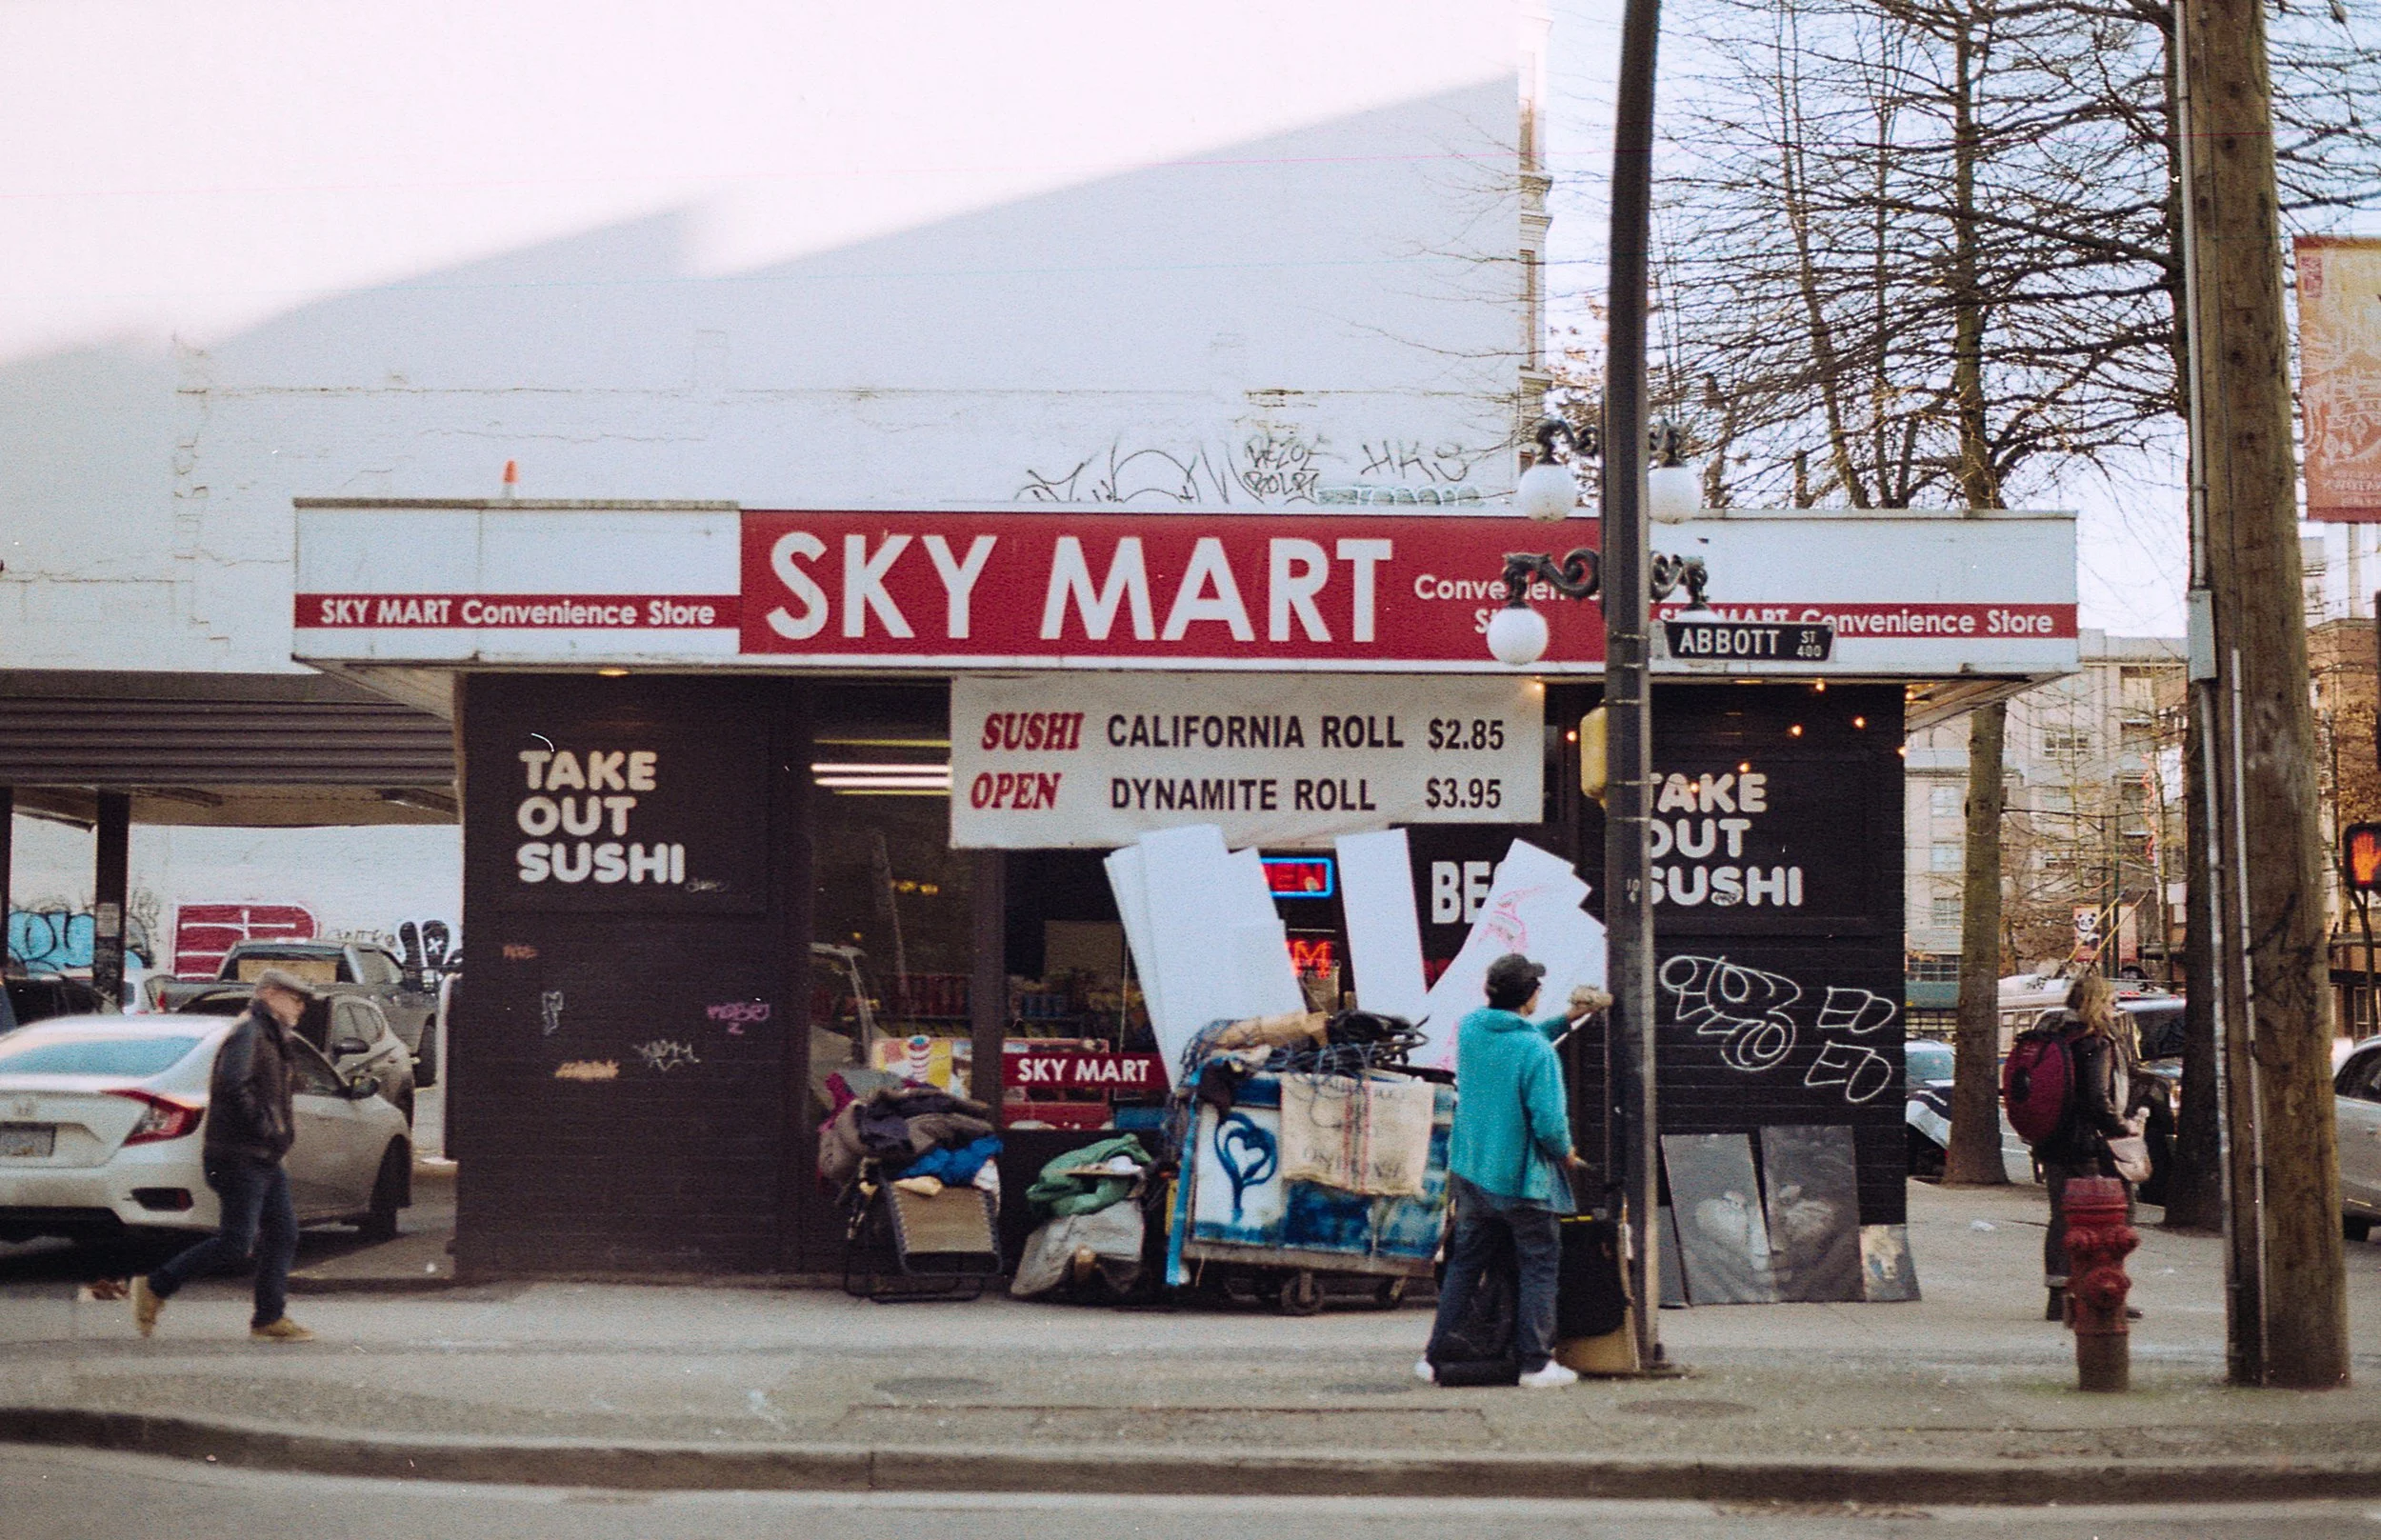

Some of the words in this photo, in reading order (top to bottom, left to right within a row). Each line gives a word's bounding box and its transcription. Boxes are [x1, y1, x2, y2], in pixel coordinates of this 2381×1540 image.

[766, 531, 997, 640] SKY
[1040, 536, 1392, 643] MART
[320, 599, 370, 624] SKY
[376, 599, 452, 624] MART
[461, 599, 637, 625] Convenience
[648, 600, 715, 626] Store
[1987, 608, 2053, 634] Store
[1678, 628, 1780, 655] ABBOTT
[1801, 630, 1815, 644] ST
[1796, 645, 1821, 657] 400
[982, 712, 1084, 751] SUSHI
[1108, 714, 1304, 749] CALIFORNIA
[1321, 714, 1404, 749] ROLL
[1428, 716, 1505, 750] $2.85
[519, 750, 657, 791] TAKE
[970, 772, 1063, 810] OPEN
[1112, 777, 1277, 810] DYNAMITE
[1294, 778, 1376, 811] ROLL
[1425, 777, 1502, 810] $3.95
[517, 795, 637, 836] OUT
[516, 842, 685, 885] SUSHI
[1262, 864, 1325, 891] EN
[1017, 1057, 1068, 1082] SKY
[1074, 1058, 1150, 1082] MART
